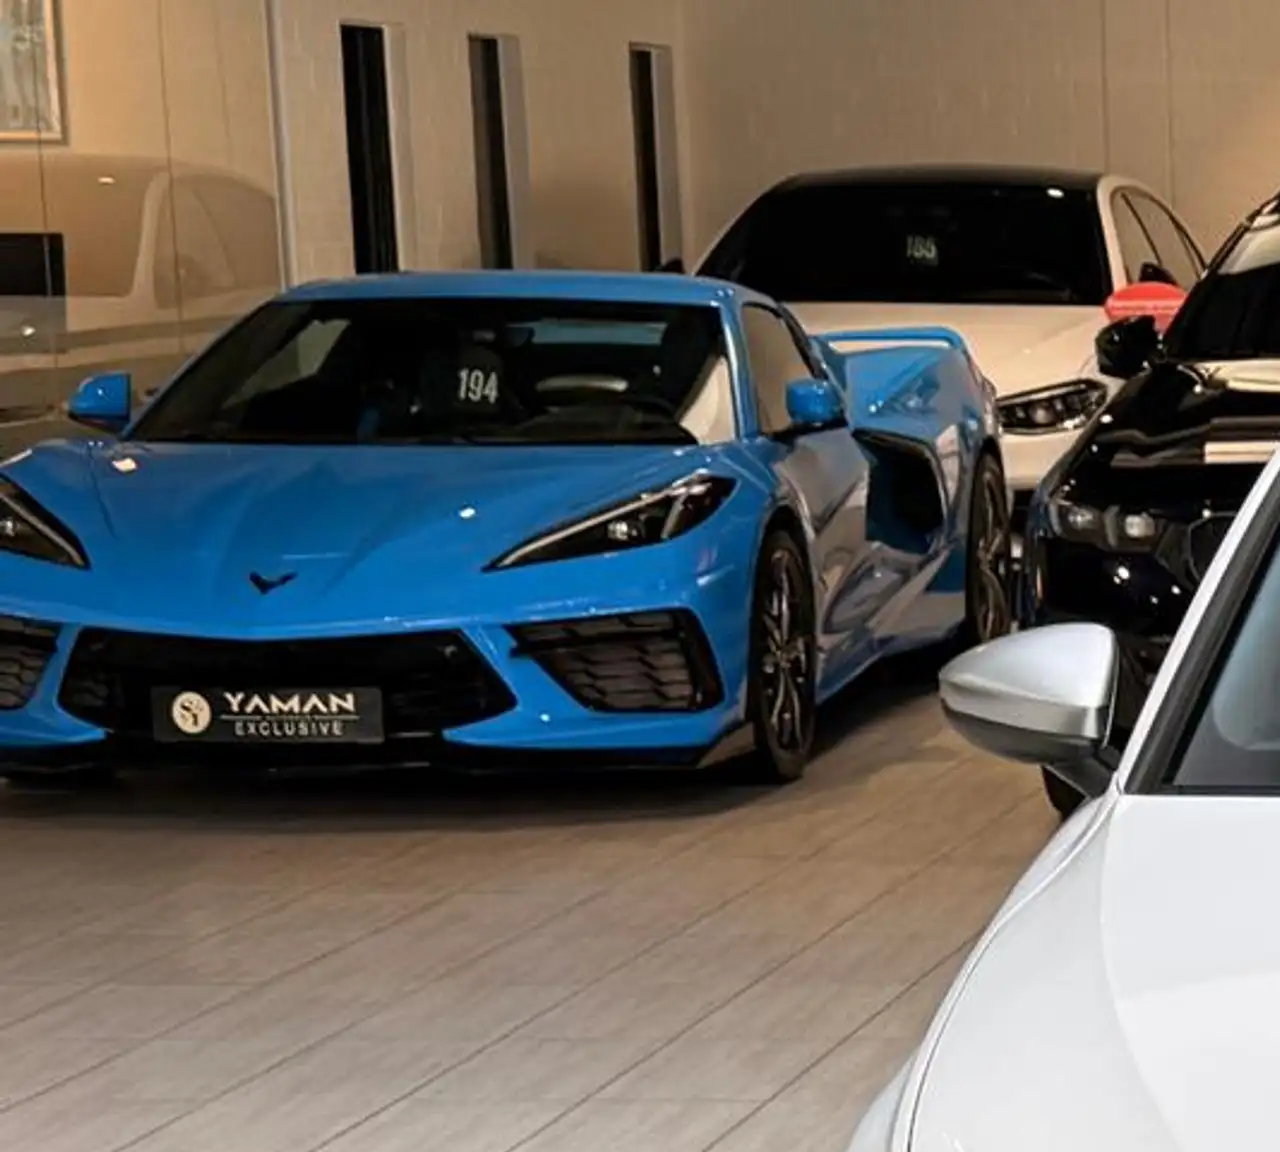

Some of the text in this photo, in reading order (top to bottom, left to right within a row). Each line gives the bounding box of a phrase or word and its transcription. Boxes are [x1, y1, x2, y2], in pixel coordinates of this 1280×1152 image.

[458, 368, 498, 404] 194
[223, 691, 356, 713] YAMAN
[234, 719, 344, 736] EXCLUSIVE
